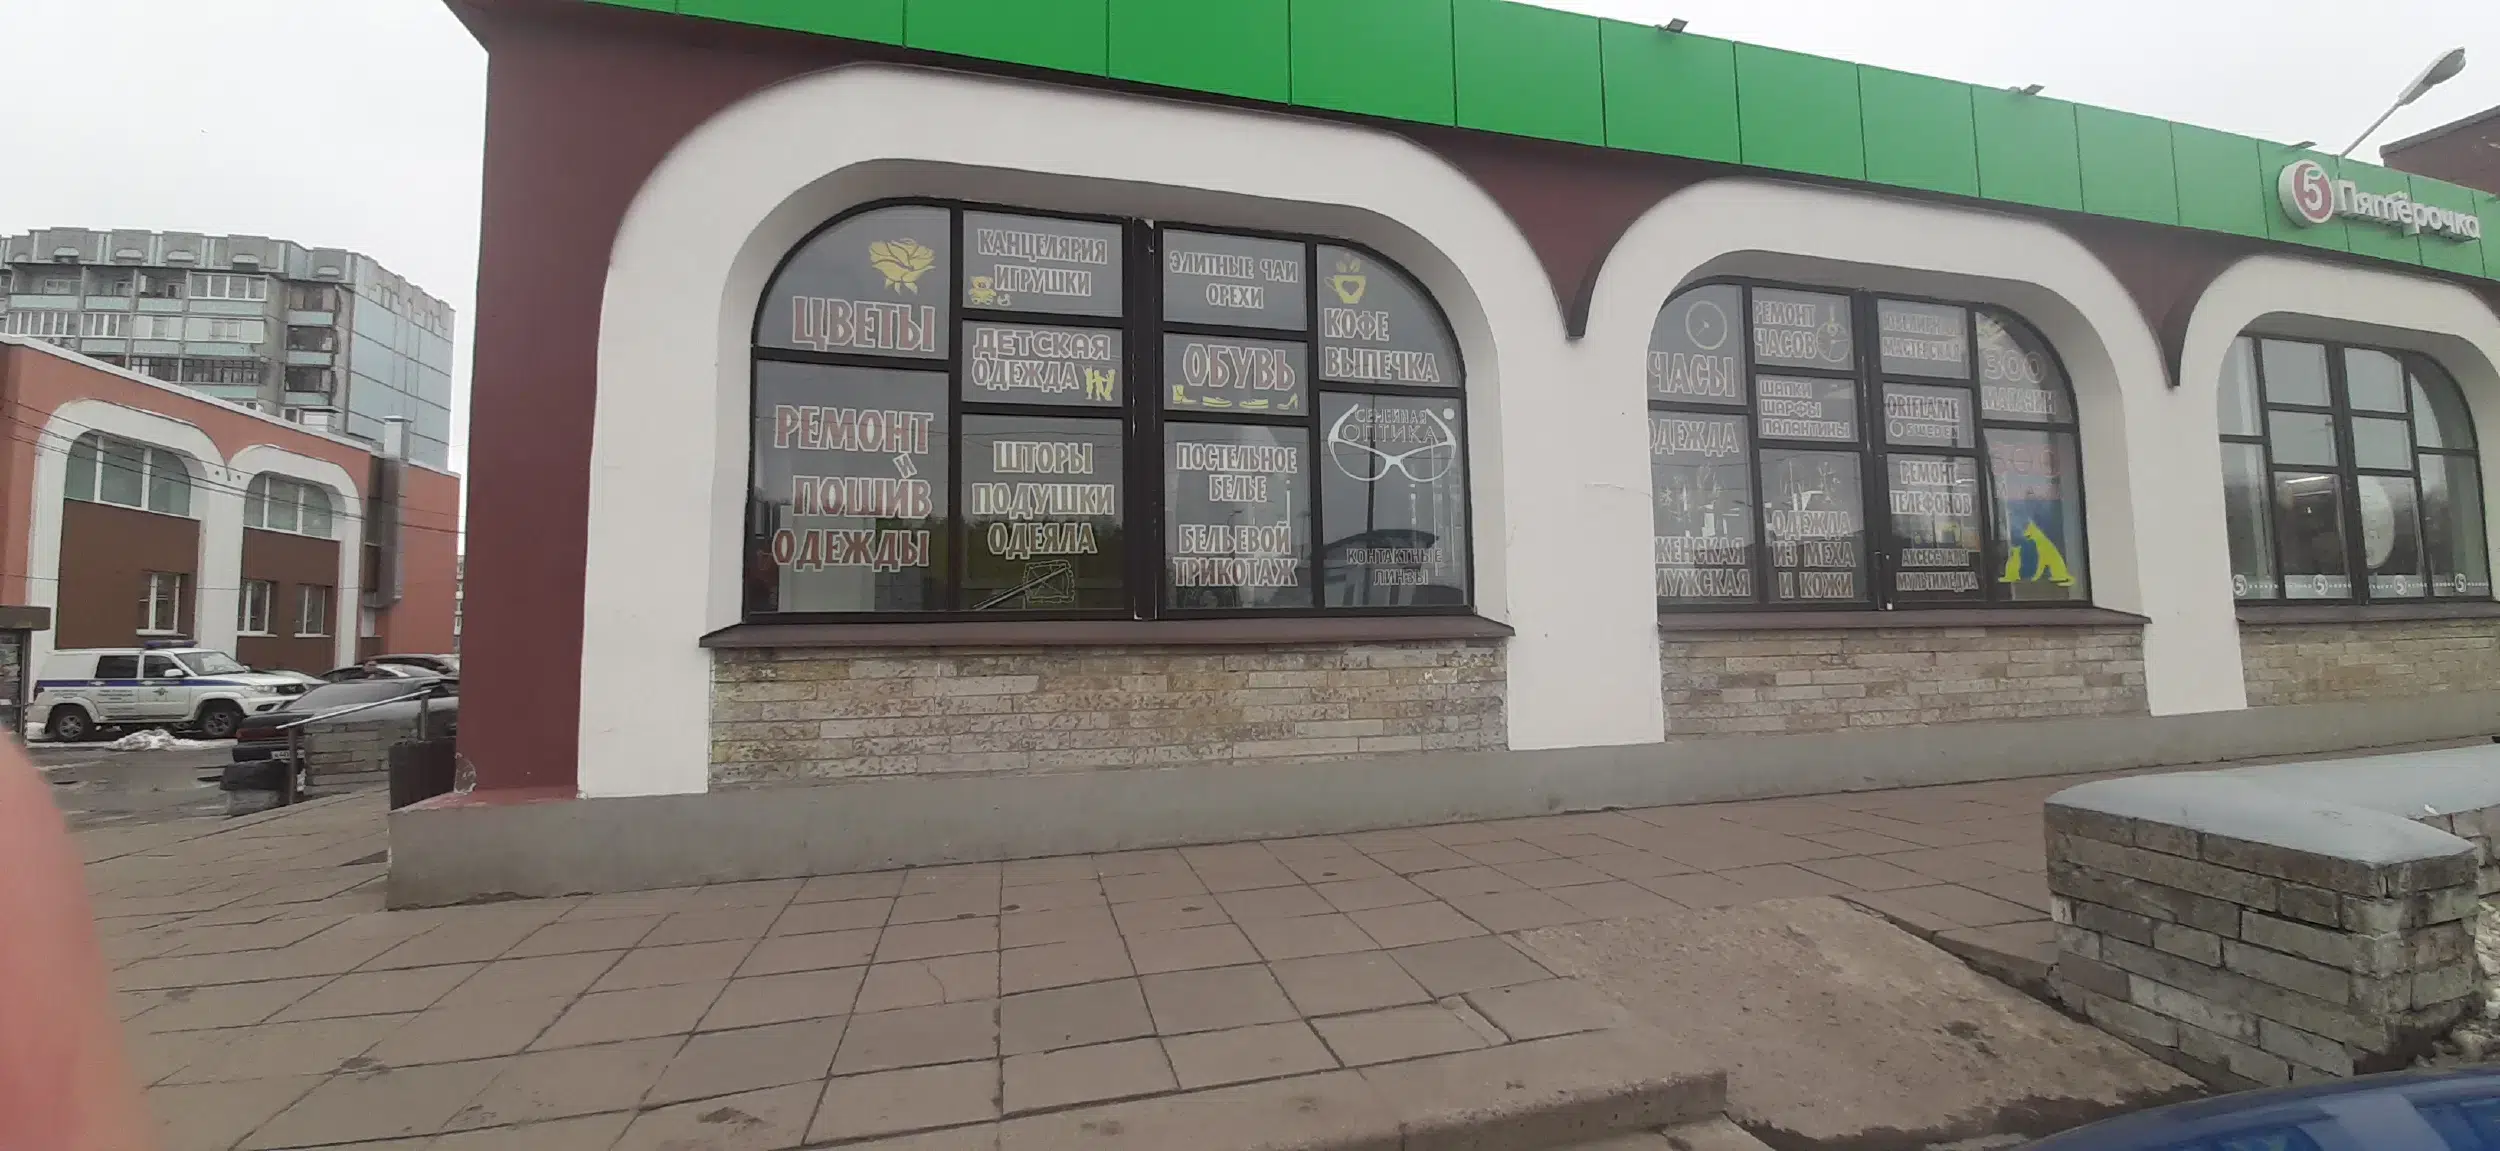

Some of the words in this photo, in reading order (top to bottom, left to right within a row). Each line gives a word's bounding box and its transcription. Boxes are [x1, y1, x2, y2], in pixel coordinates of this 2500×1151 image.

[2337, 179, 2481, 240] Пятёрочка
[977, 228, 1108, 265] КАНЦЕЛЯРИЯ
[993, 264, 1092, 297] ИГРУШКИ
[1169, 250, 1254, 280] ЭЛИТНЫЕ
[1260, 259, 1299, 283] ЧАИ
[1206, 283, 1264, 310] ОРЕХИ
[792, 296, 936, 352] ЦВЕТЫ
[1324, 307, 1391, 342] КОФЕ
[1752, 300, 1816, 328] РЕМОНТ
[972, 328, 1112, 360] ДЕТСКАЯ
[1753, 327, 1818, 360] ЧАСОВ
[972, 360, 1080, 393] ОДЕЖДА
[1182, 343, 1296, 392] ОБУВЬ
[1325, 347, 1441, 383] ВЫПЕЧКА
[1647, 350, 1736, 398] ЧАСЫ
[1983, 348, 2046, 384] ЗОО
[1758, 379, 1813, 398] ШАПКИ
[1981, 385, 2056, 416] МАГАЗИН
[1760, 399, 1822, 418] ШАРФЫ
[1886, 393, 1961, 422] ORIFLAME
[773, 404, 934, 455] РЕМОНТ
[1341, 423, 1440, 445] ОПТИКА
[1761, 418, 1850, 438] ПАЛАНТИНЫ
[1906, 423, 1960, 440] SWEDEN
[993, 441, 1094, 474] ШТОРЫ
[1176, 442, 1298, 474] ПОСТЕЛЬНОЕ
[1899, 460, 1957, 486] РЕМОНТ
[792, 475, 933, 520] ПОШИВ
[972, 482, 1115, 520] ПОДУШКИ
[1208, 475, 1268, 503] БЕЛЬЕ
[1889, 489, 1973, 517] ТЕЛЕФОНОВ
[1178, 520, 1292, 555] БЕЛЬЕВОЙ
[1771, 509, 1853, 540] ОДЕЖДА
[772, 529, 930, 573] ОДЕЖДЫ
[987, 522, 1098, 561] ОДЕЯЛА
[1346, 548, 1444, 567] КОНТАКТНЫЕ
[1655, 536, 1746, 565] ЖЕНСКАЯ
[1772, 541, 1799, 567] ИЗ
[1803, 541, 1856, 567] МЕХА
[1901, 548, 1970, 567] АКСЕССУАРЫ
[1173, 557, 1299, 589] ТРИКОТАЖ
[1372, 568, 1429, 588] ЛИНЗЫ
[1778, 571, 1795, 598] И
[1799, 571, 1854, 598] КОЖИ
[1896, 571, 1979, 592] МУЛЬТИМЕДИА
